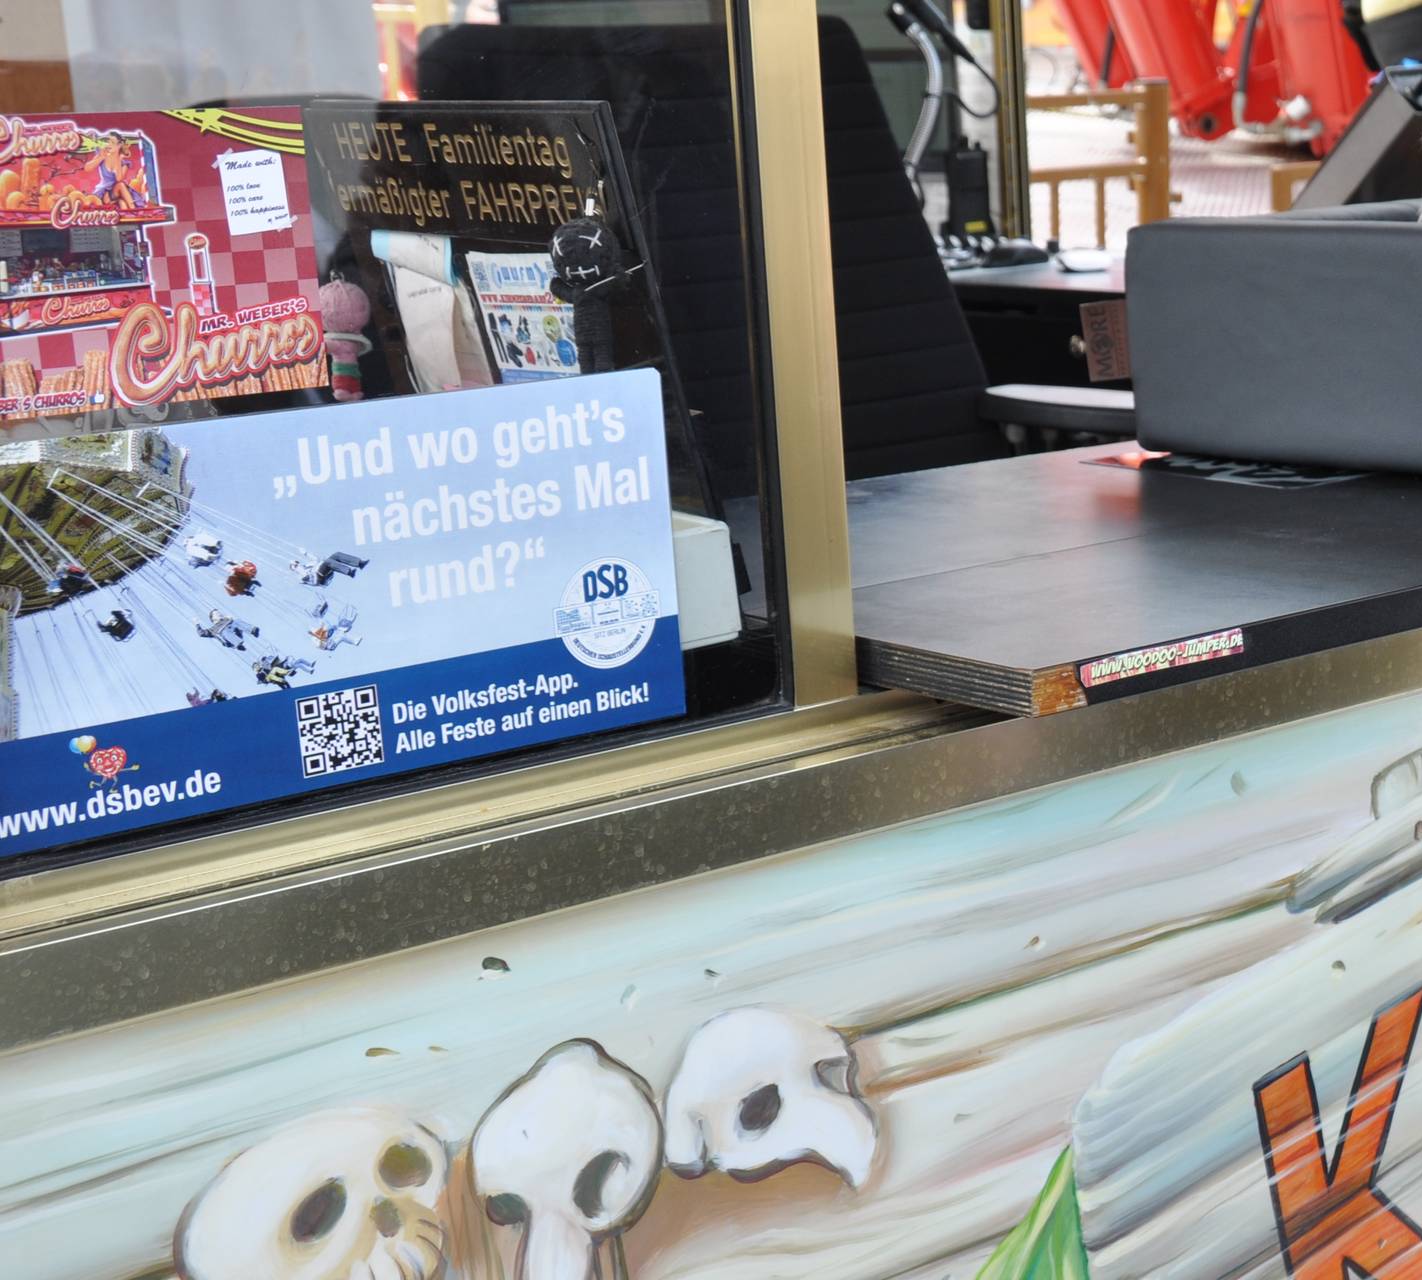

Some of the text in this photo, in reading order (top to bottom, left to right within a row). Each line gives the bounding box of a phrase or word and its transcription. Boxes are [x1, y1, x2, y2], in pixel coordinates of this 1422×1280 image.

[332, 123, 573, 178] HEUTE Familientag
[337, 177, 450, 227] ermäßigter
[201, 299, 306, 333] MR. WEBER'S
[111, 302, 319, 406] Churros
[34, 392, 86, 410] CHURROS
[408, 426, 477, 467] wo
[351, 458, 650, 546] nächstes Mal
[582, 564, 628, 603] DSB
[392, 673, 578, 725] Die Volksfest-App.
[396, 682, 650, 754] Alle Feste auf einen Blick!
